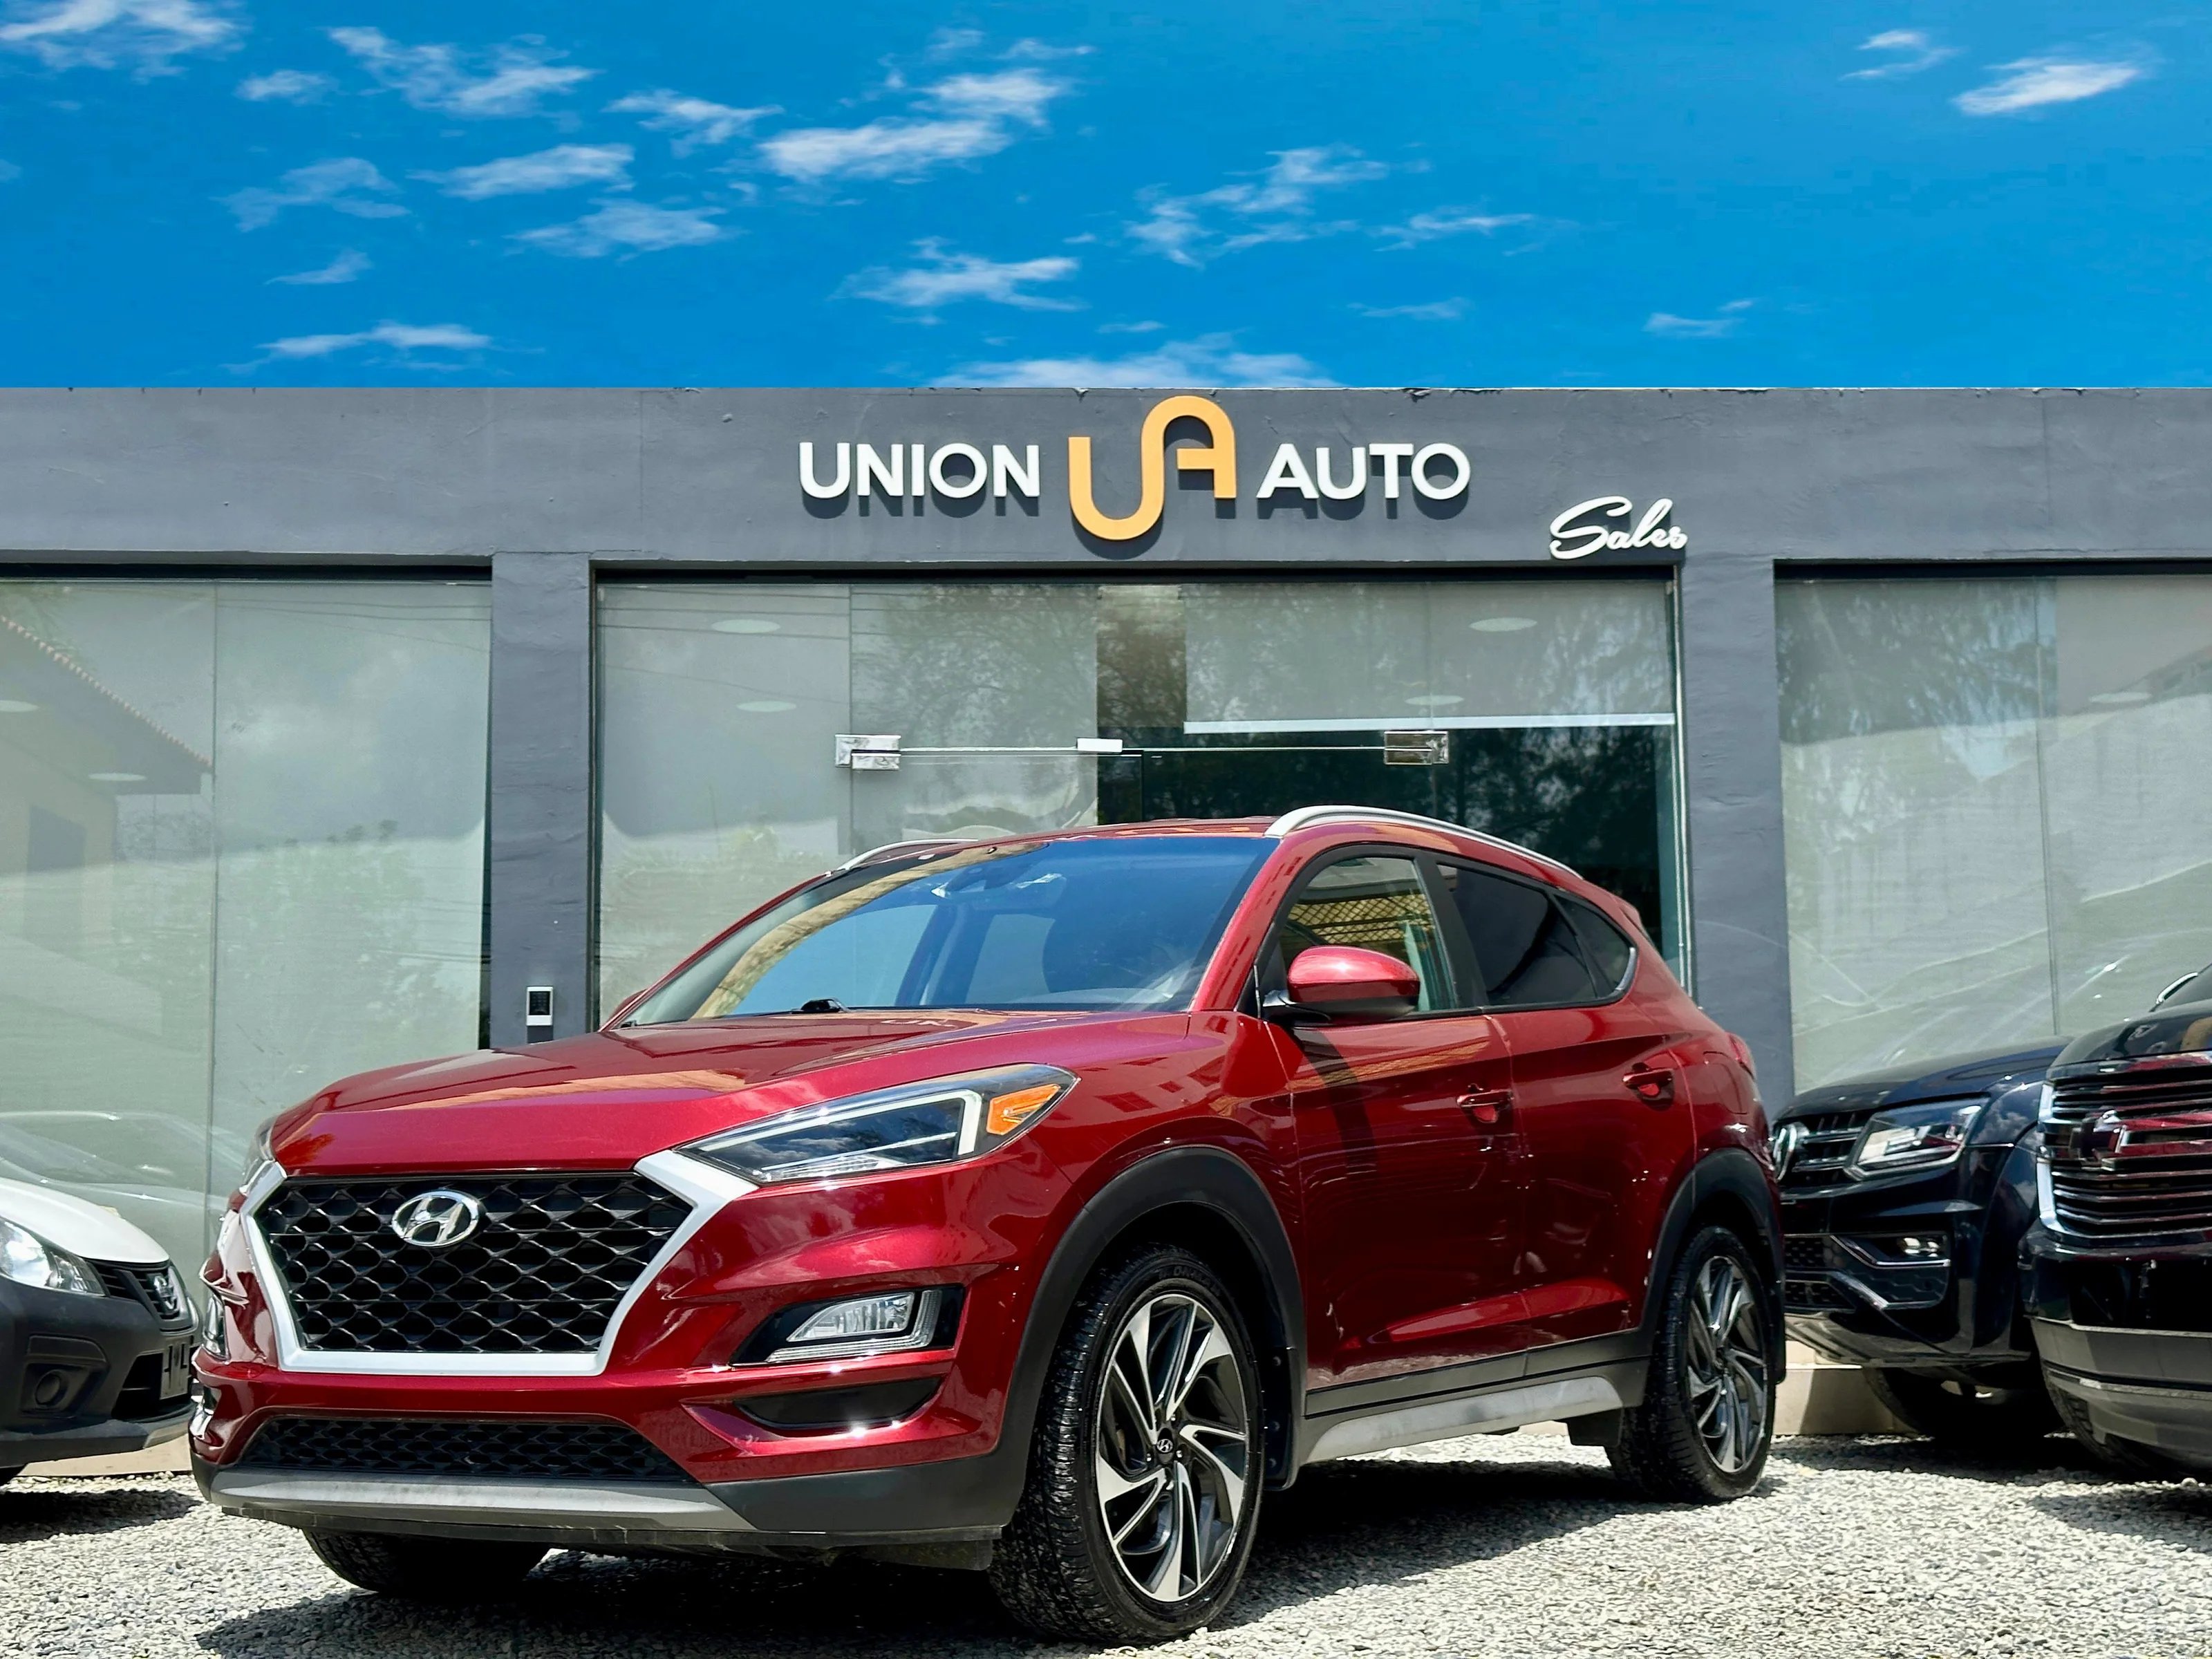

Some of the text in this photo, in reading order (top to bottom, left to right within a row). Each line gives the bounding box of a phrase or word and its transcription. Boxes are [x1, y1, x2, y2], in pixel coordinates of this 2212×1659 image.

[800, 442, 1040, 498] UNION
[1257, 444, 1470, 499] AUTO
[1550, 496, 1687, 559] Sales
